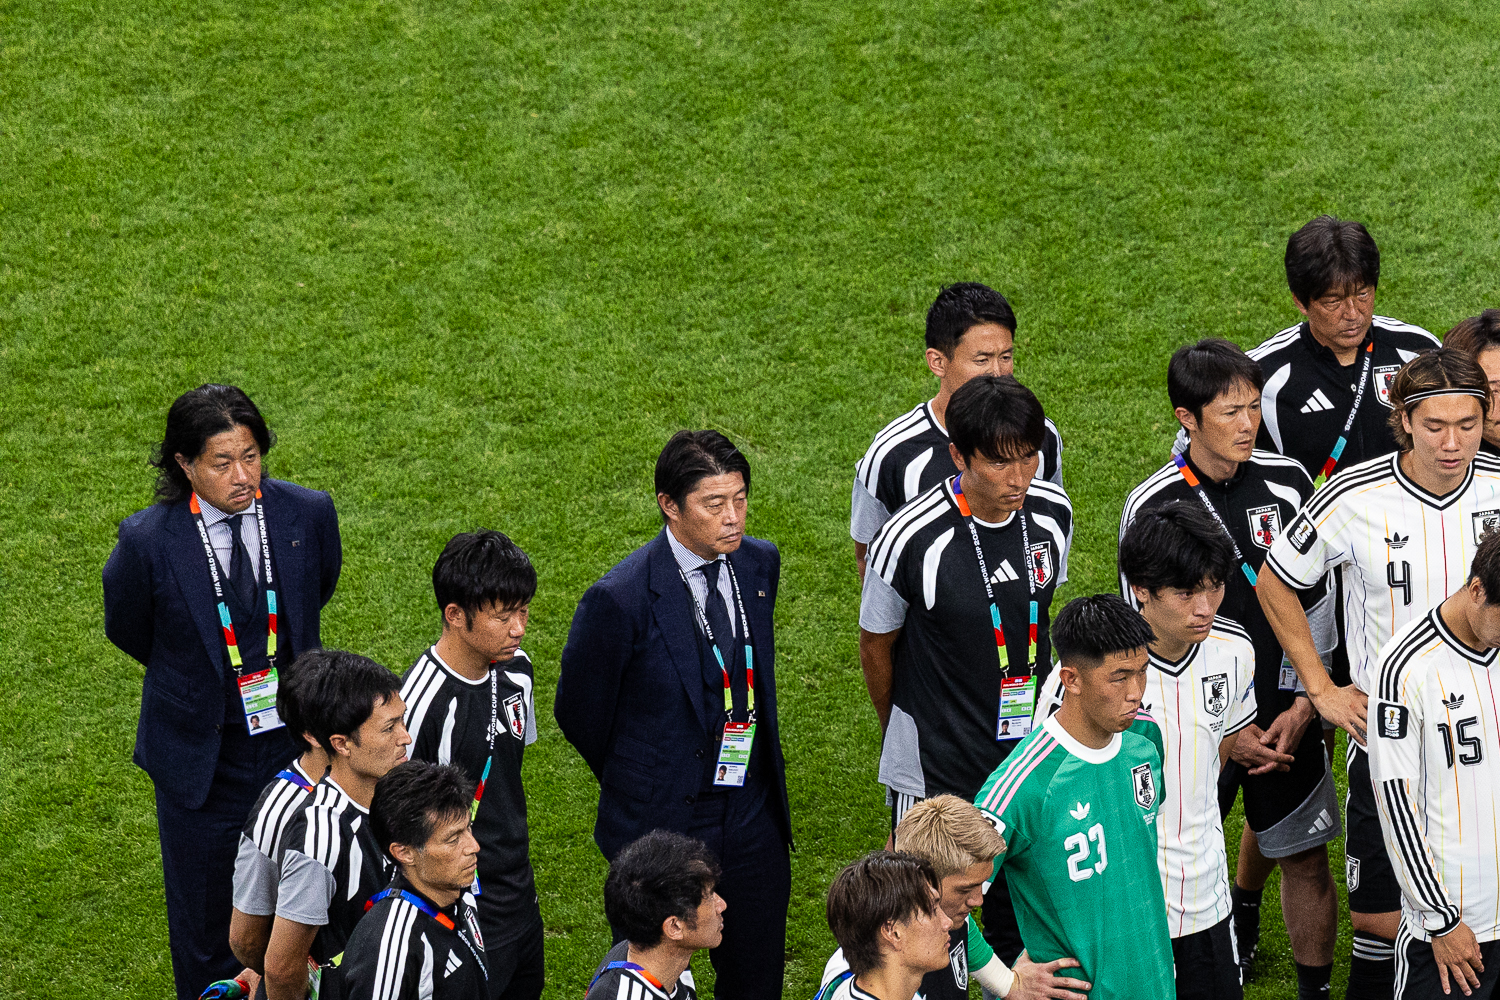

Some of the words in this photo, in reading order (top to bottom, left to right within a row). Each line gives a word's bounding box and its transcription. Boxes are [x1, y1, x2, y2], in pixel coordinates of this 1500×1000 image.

[1356, 370, 1367, 394] WORLD
[1353, 394, 1361, 408] CUP
[1343, 407, 1356, 431] 2026
[1197, 488, 1215, 513] 2026
[196, 519, 209, 544] 2026
[968, 521, 980, 546] 2026
[204, 543, 213, 557] CUP
[258, 518, 267, 544] WORLD
[264, 558, 272, 583] 2026
[975, 545, 983, 559] CUP
[1022, 529, 1030, 554] WORLD
[1027, 569, 1035, 594] 2026
[207, 557, 219, 582] WORLD
[978, 559, 990, 584] WORLD
[214, 581, 223, 596] FIFA
[985, 582, 993, 598] FIFA
[1387, 560, 1412, 607] 4
[704, 625, 714, 639] FIFA
[740, 613, 749, 638] 2026
[1437, 716, 1483, 770] 15
[1064, 822, 1108, 882] 23
